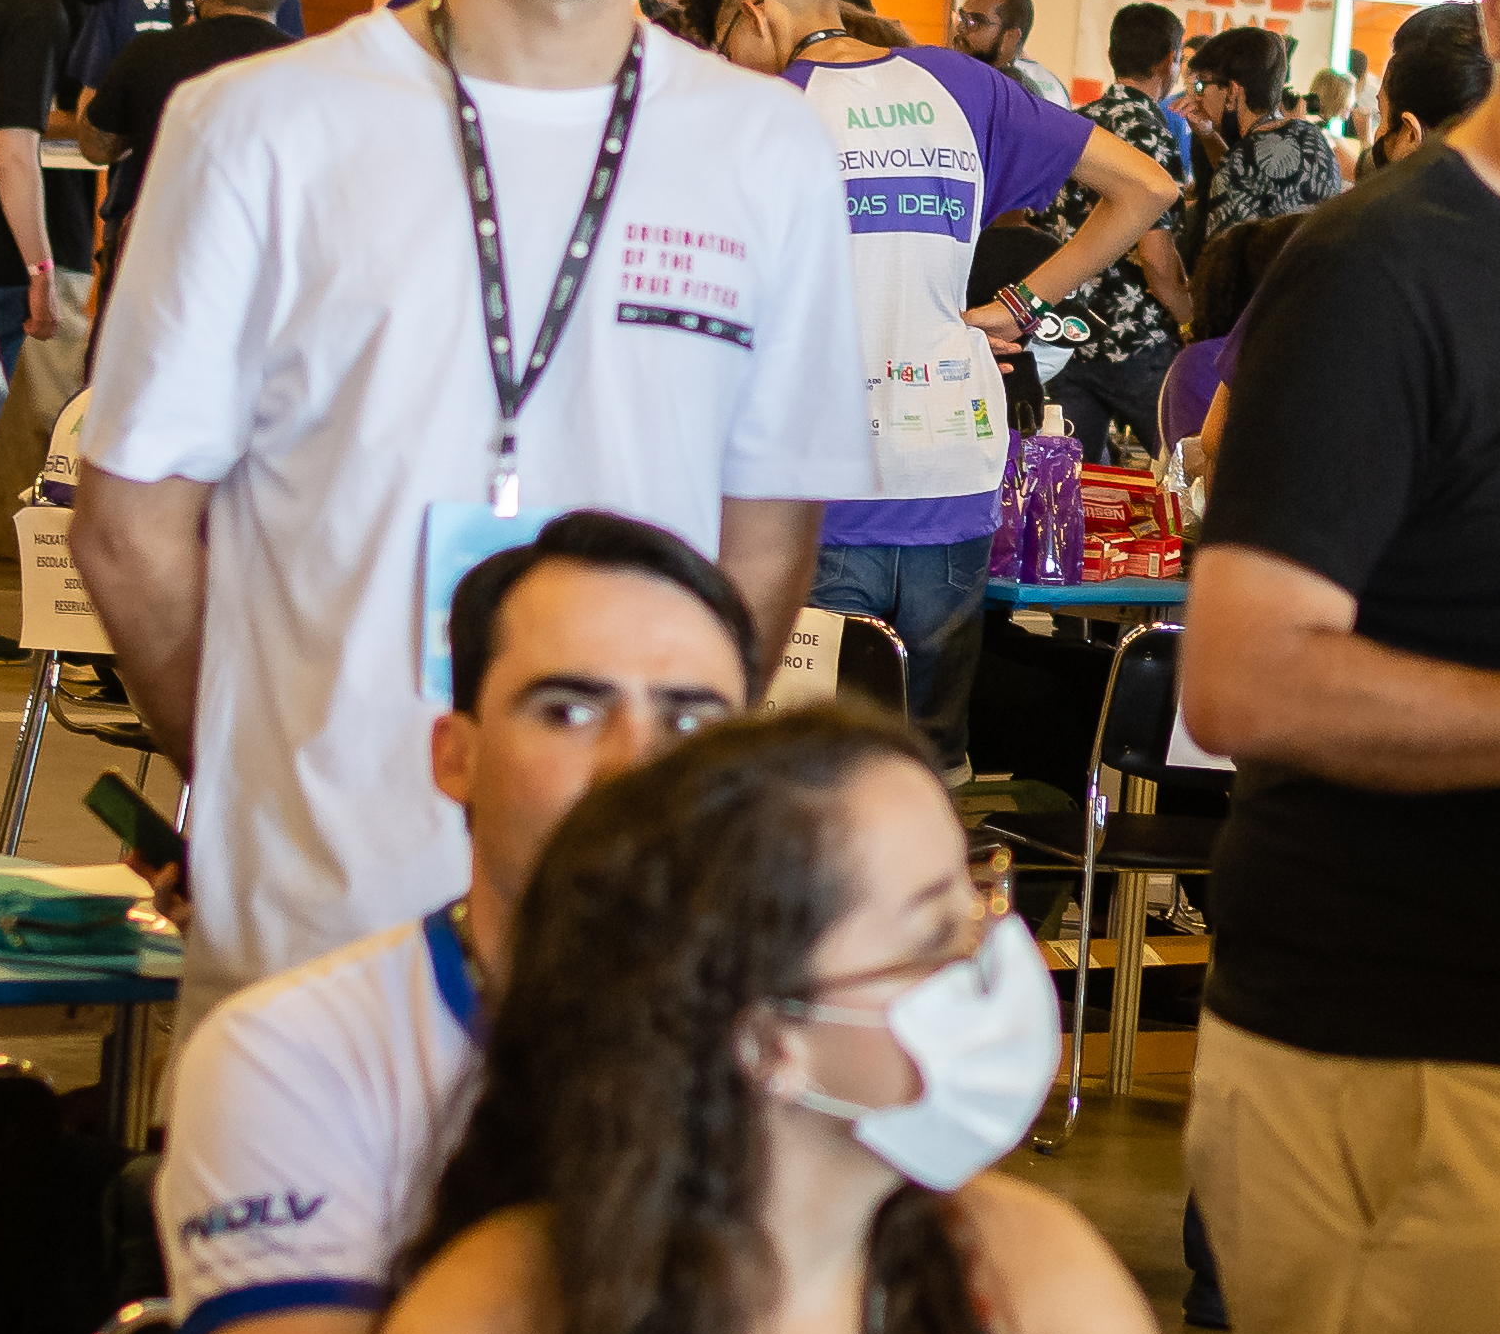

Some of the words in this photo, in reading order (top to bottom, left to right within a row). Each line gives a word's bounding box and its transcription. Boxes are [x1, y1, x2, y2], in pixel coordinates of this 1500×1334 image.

[847, 101, 935, 129] ALUNO
[837, 148, 977, 173] SENVOLVENDO
[847, 194, 887, 216] OAS
[791, 632, 820, 647] ODE
